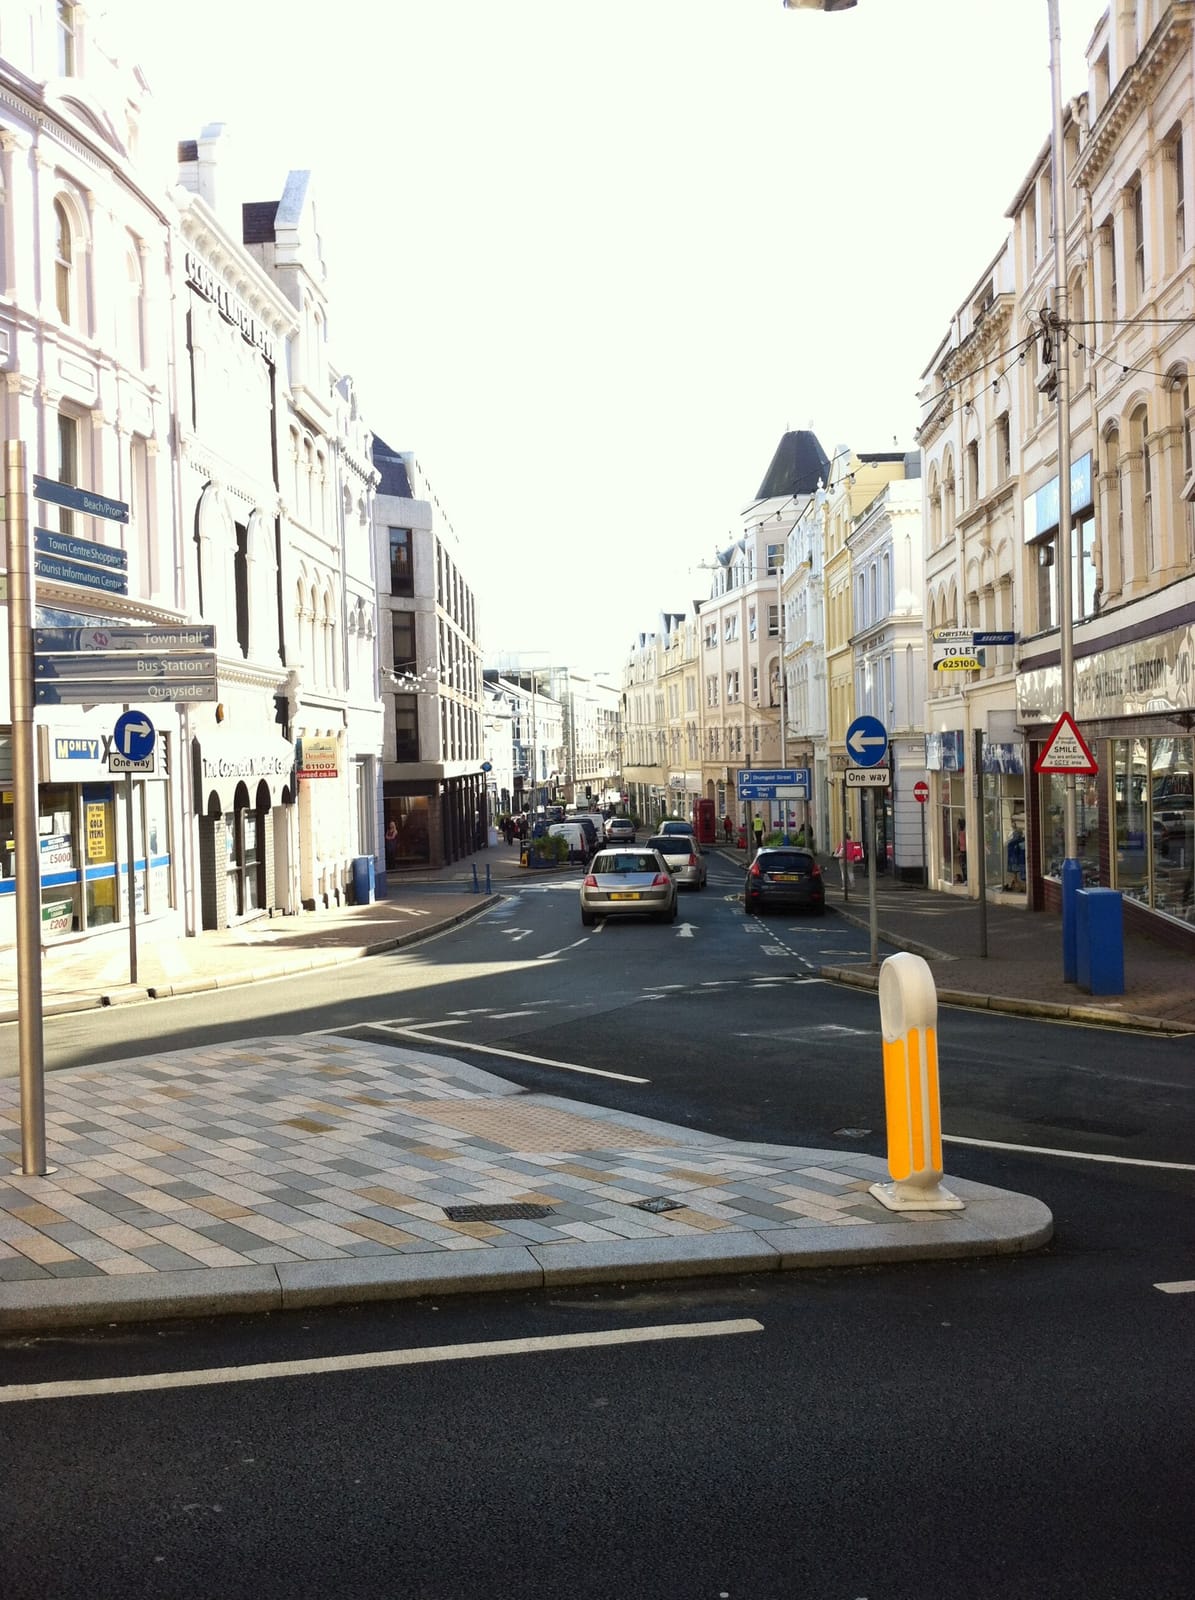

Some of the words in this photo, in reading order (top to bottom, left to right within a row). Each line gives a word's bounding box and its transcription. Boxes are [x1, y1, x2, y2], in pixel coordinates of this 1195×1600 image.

[83, 497, 122, 516] Beach/Prom
[48, 537, 68, 552] Town
[68, 543, 90, 557] Centre
[91, 548, 121, 567] Shopping
[37, 561, 61, 575] Tourist
[62, 567, 101, 585] Information
[101, 575, 122, 588] Centre
[144, 633, 176, 644] Town
[180, 632, 202, 643] Hall
[944, 647, 957, 655] TO
[960, 647, 976, 655] LET
[137, 660, 158, 672] Bus
[160, 660, 203, 671] Station
[943, 660, 975, 668] 625100
[148, 685, 203, 698] Quayside
[57, 740, 97, 758] MONEY
[113, 758, 131, 767] One
[133, 759, 150, 769] way
[743, 774, 750, 782] P
[796, 773, 802, 782] P
[848, 773, 866, 781] One
[869, 774, 887, 783] way
[90, 819, 102, 828] GOLD
[90, 830, 104, 839] ITEMS
[50, 853, 71, 864] £5000
[50, 918, 68, 930] £200
